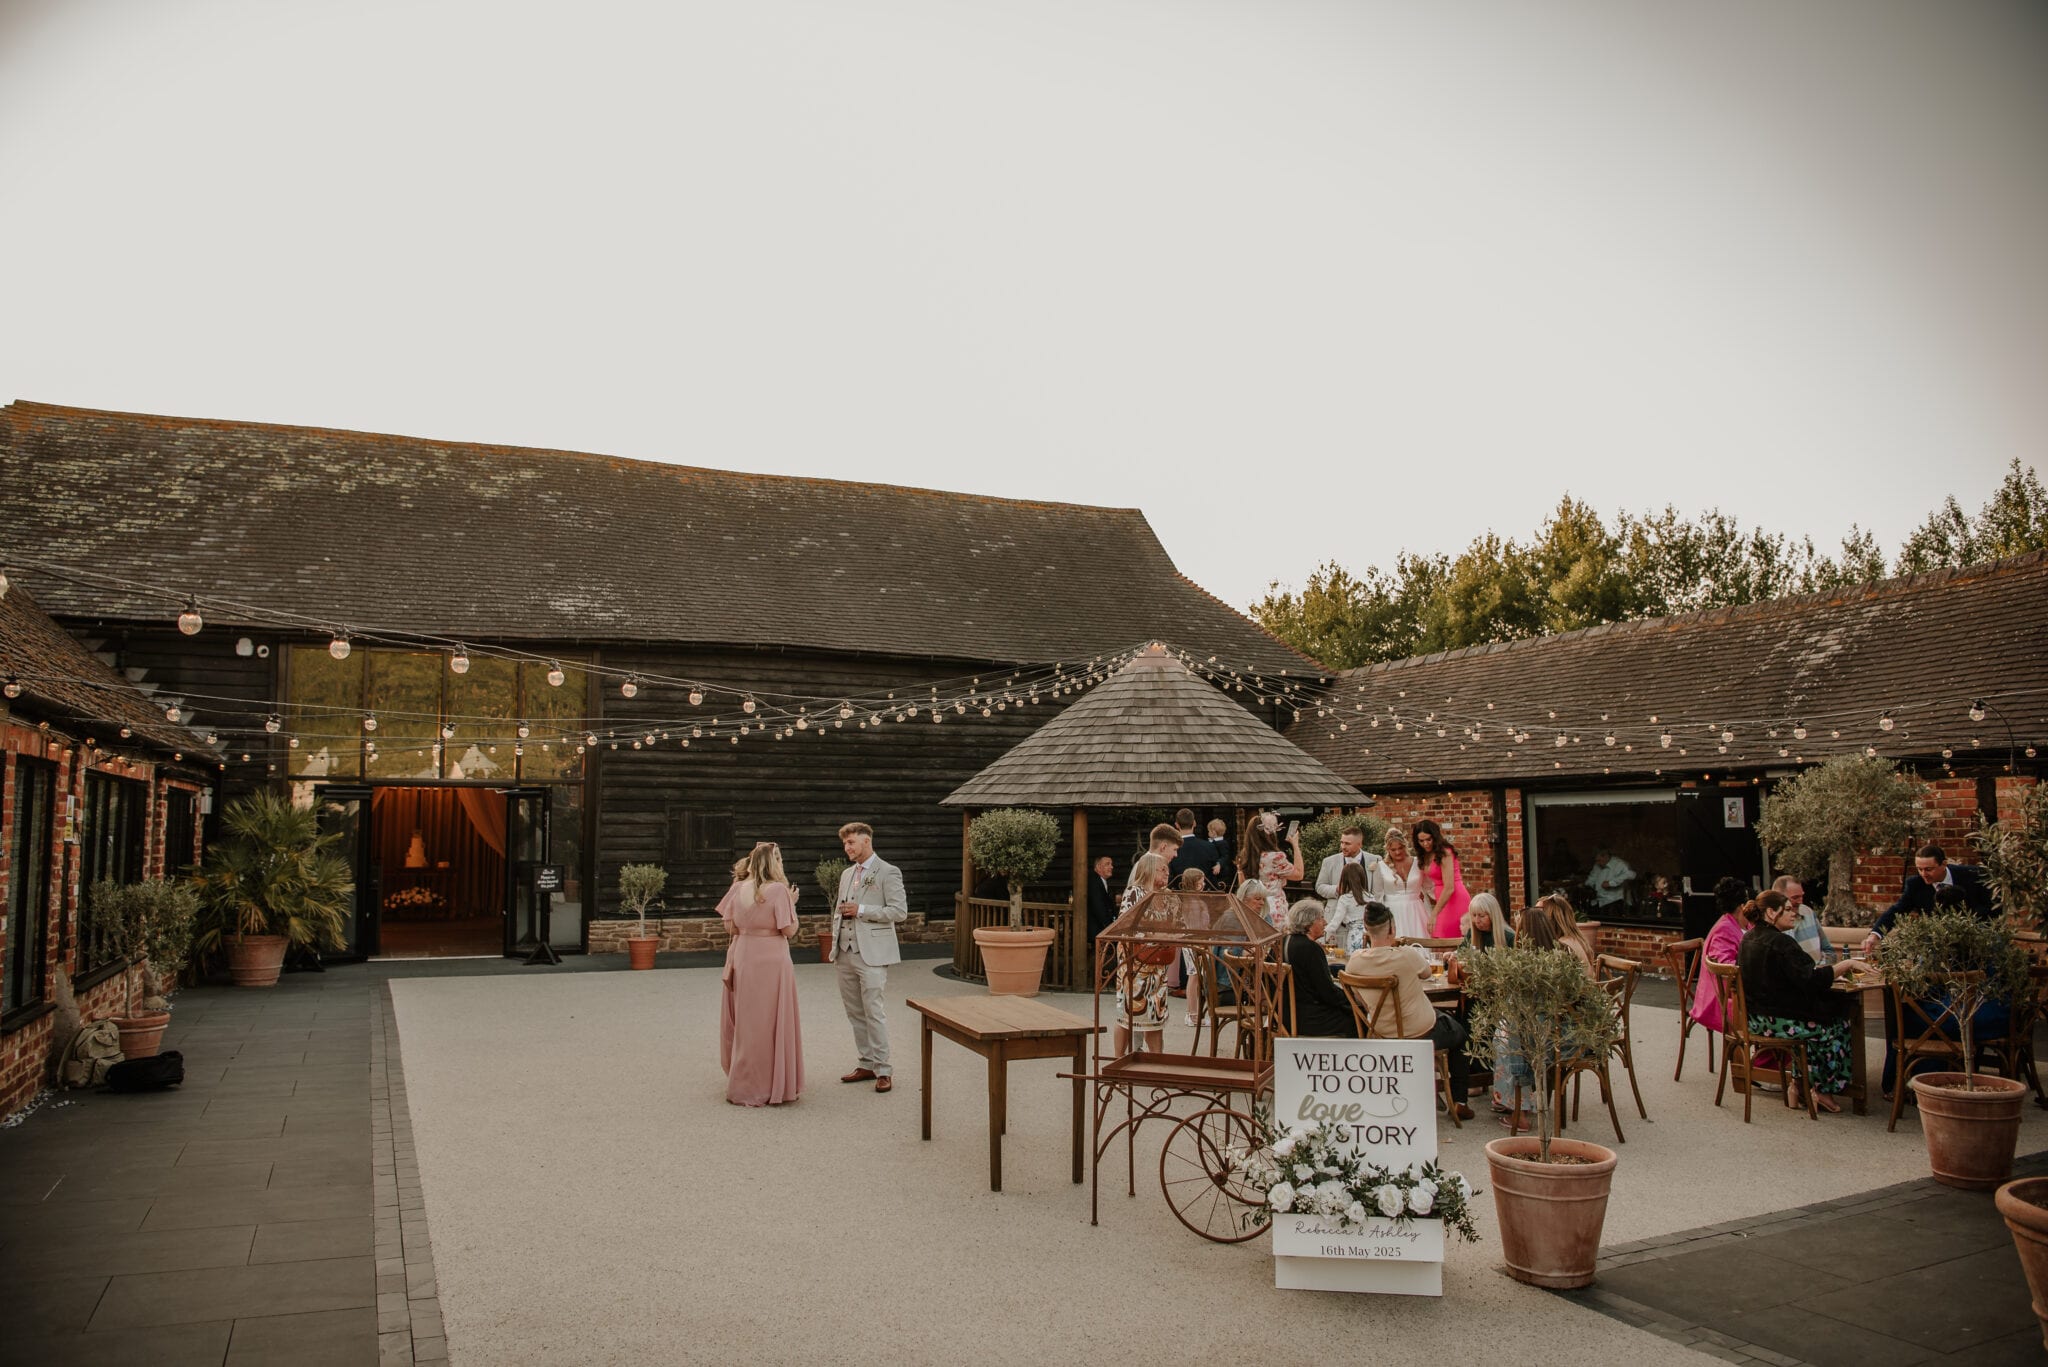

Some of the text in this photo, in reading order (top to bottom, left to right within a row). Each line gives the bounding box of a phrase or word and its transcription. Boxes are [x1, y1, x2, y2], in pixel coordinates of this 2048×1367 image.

[1292, 1052, 1414, 1074] WELCOME
[1307, 1074, 1401, 1095] TO OUR
[1297, 1094, 1365, 1122] love
[1335, 1123, 1418, 1146] STORY
[1294, 1220, 1422, 1242] Rebecca & Ashley
[1320, 1245, 1402, 1259] 16th May 2025
